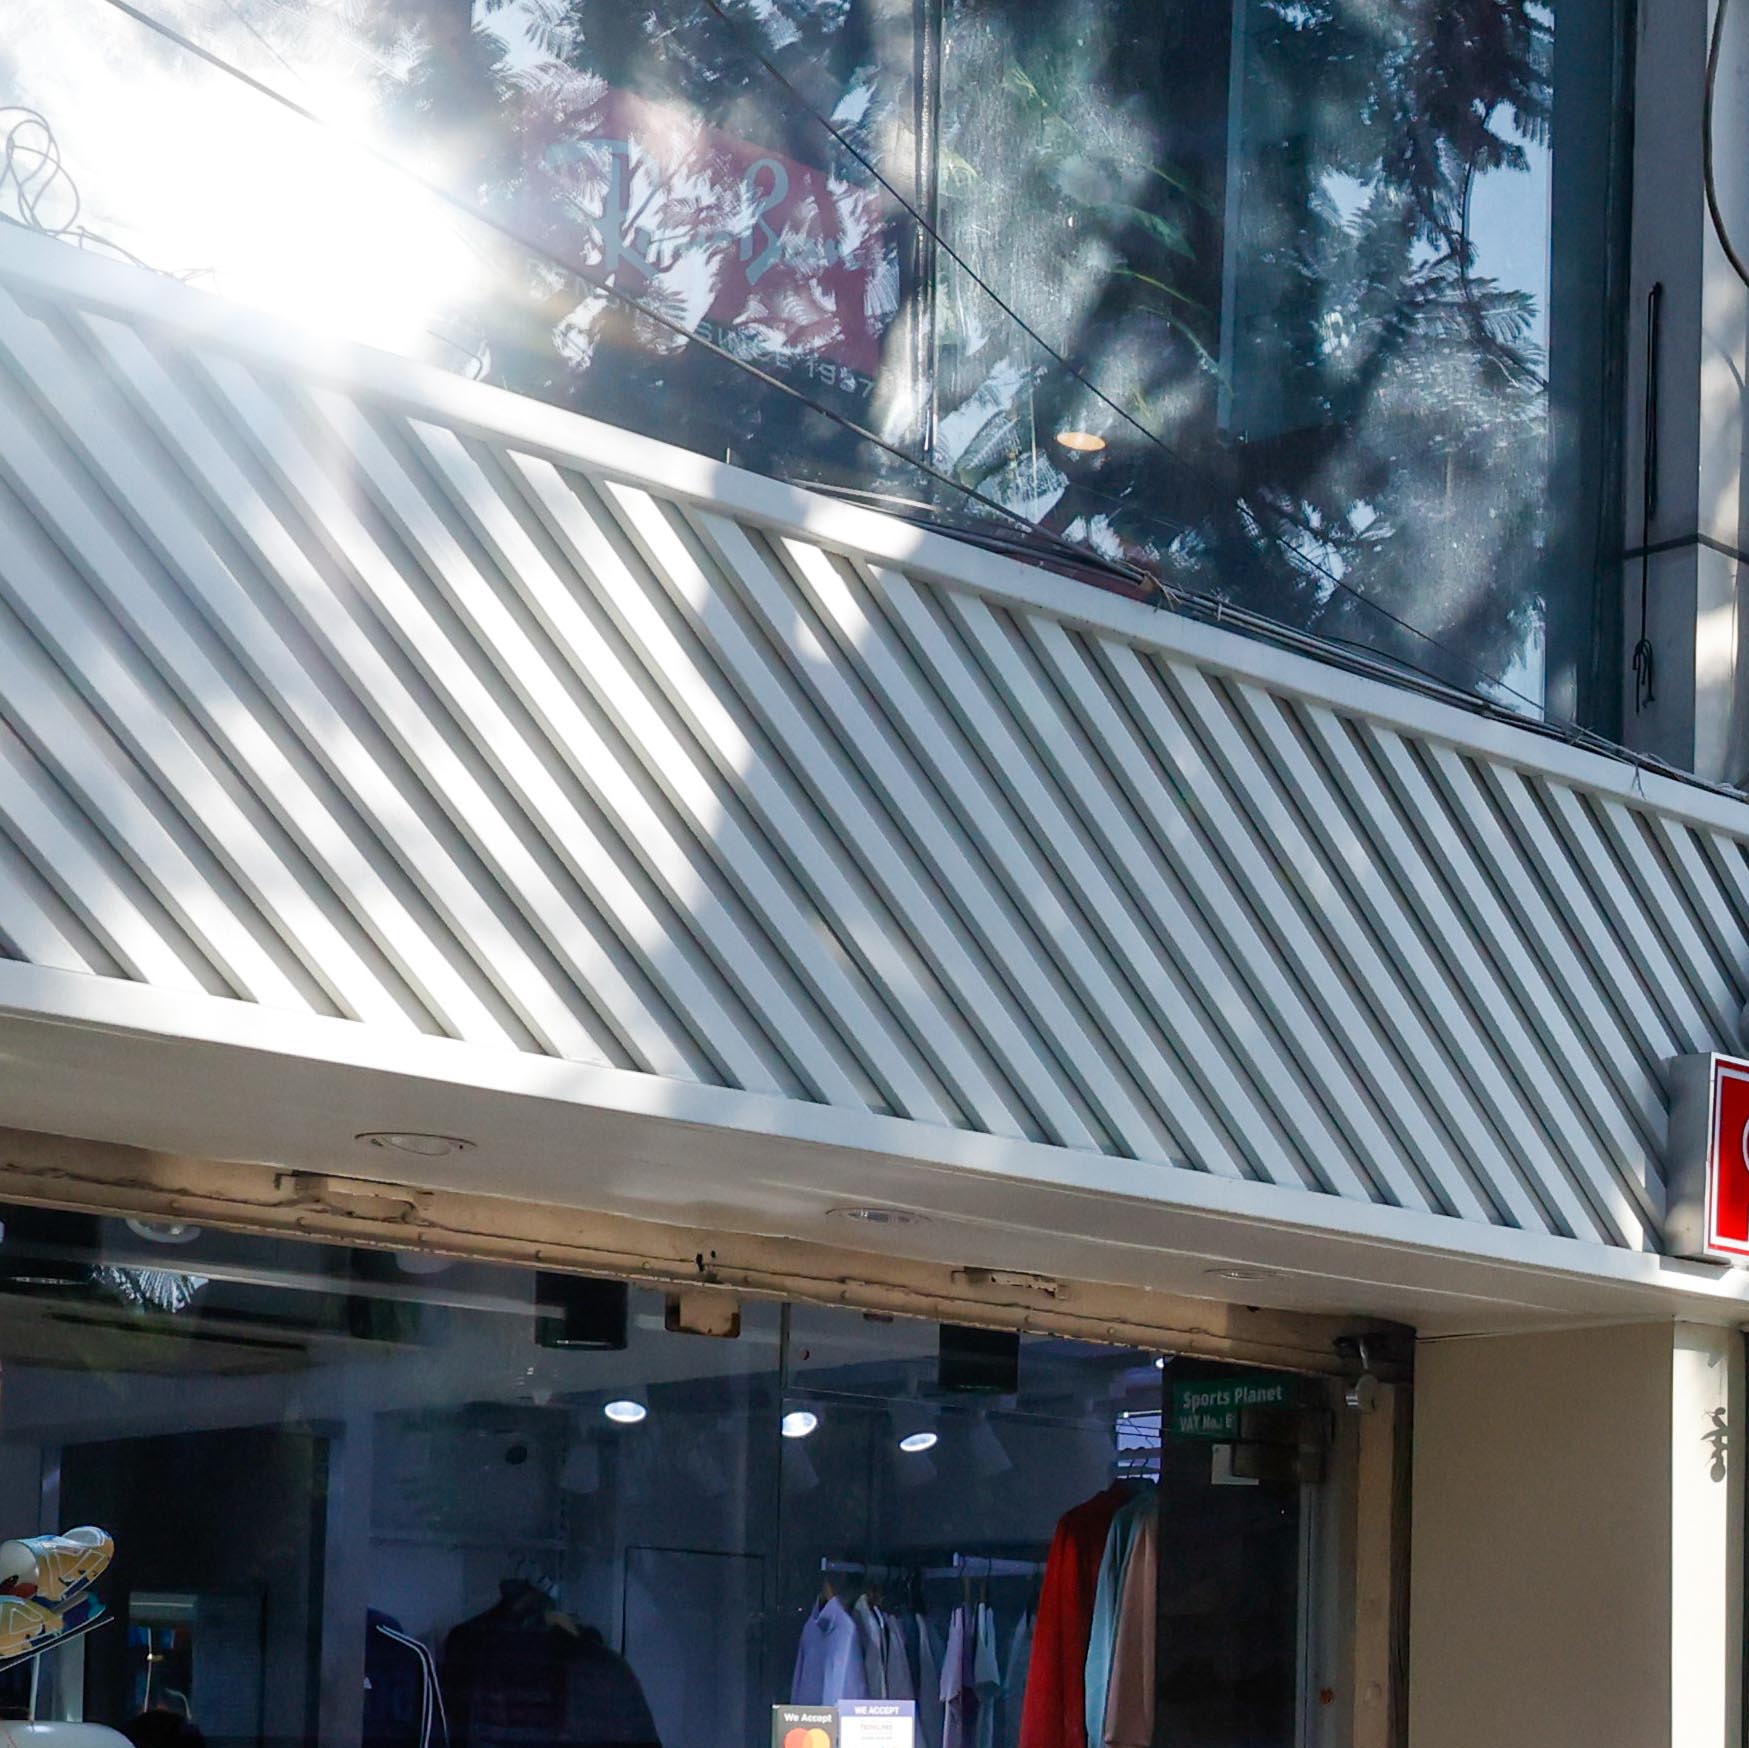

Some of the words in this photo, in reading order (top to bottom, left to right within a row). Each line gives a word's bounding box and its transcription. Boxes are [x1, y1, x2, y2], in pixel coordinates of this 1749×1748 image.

[1183, 1391, 1230, 1410] Sports
[1234, 1385, 1283, 1403] Planet
[854, 1706, 867, 1715] WE
[868, 1706, 899, 1715] ACCEPT
[783, 1713, 800, 1723] We
[801, 1713, 832, 1725] Accept
